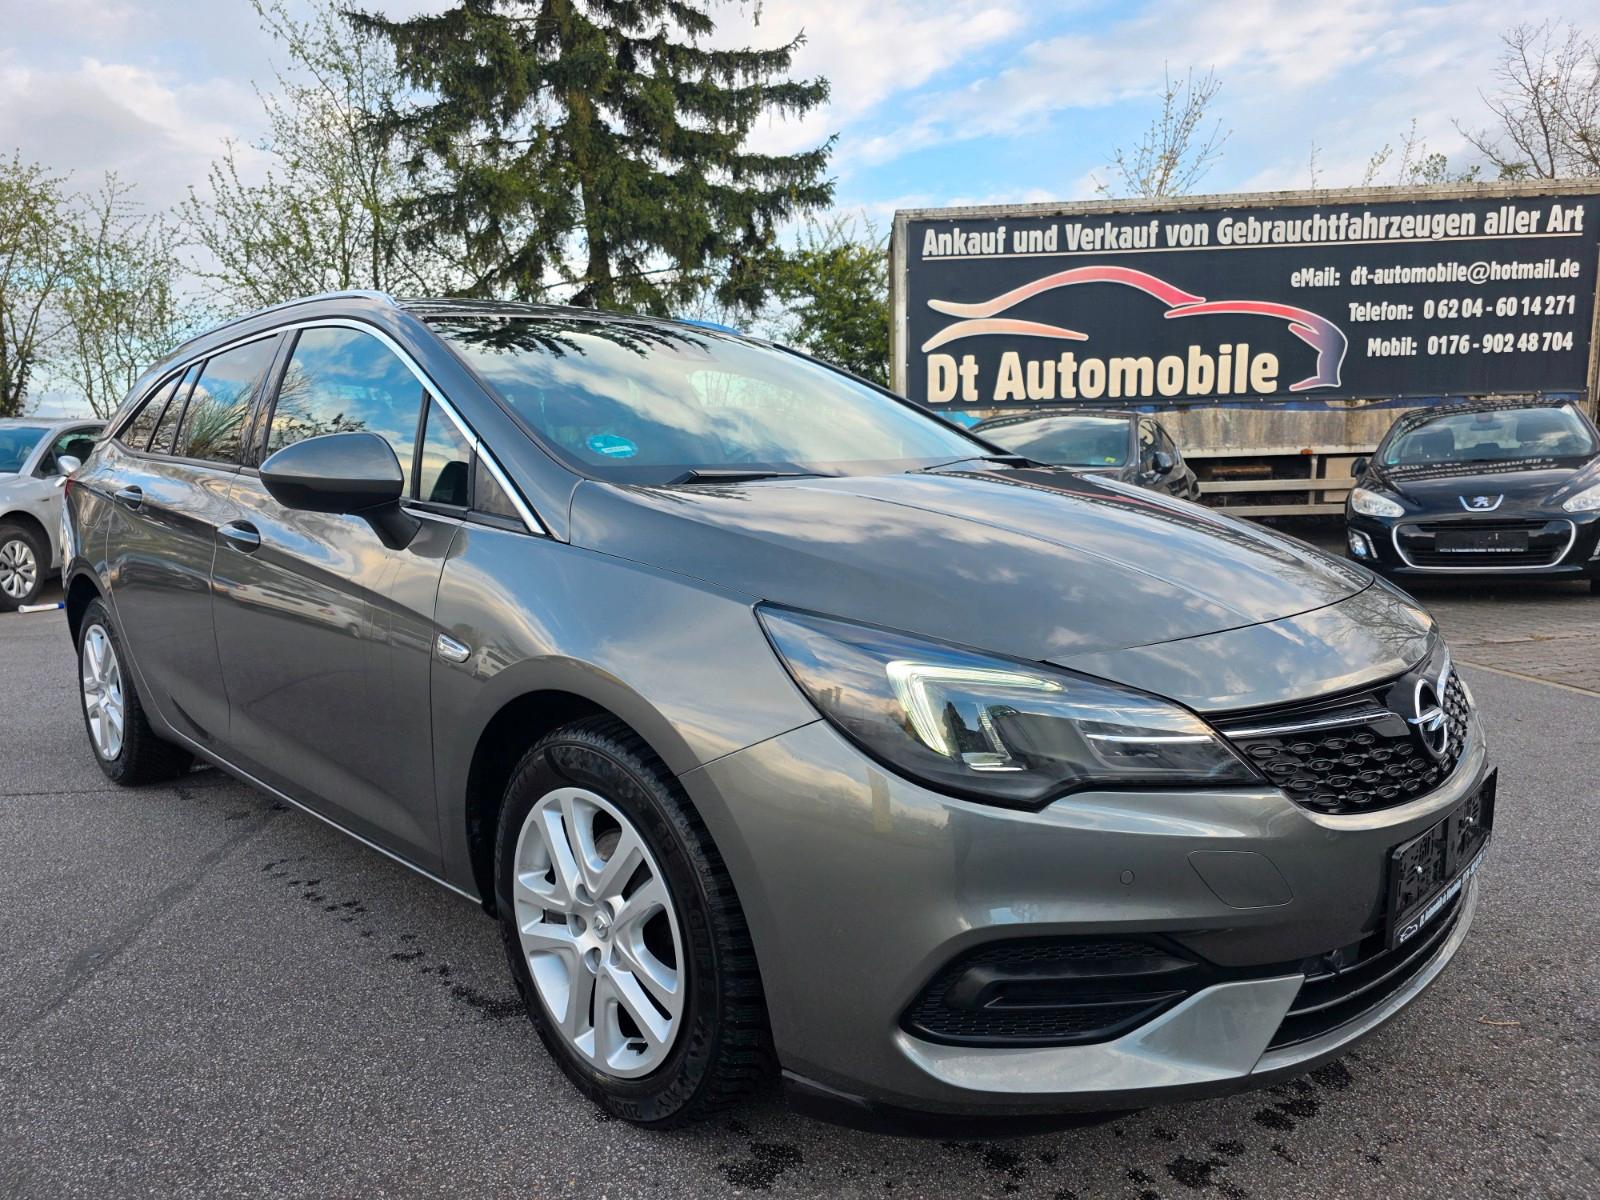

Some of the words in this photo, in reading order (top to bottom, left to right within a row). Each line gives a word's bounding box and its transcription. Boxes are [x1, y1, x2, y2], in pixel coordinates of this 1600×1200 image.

[922, 226, 1006, 256] Ankauf
[1013, 224, 1059, 254] und
[1065, 220, 1159, 250] Verkauf
[1165, 223, 1209, 246] von
[1217, 212, 1476, 240] Gebrauchtfahrzeugen
[1484, 206, 1541, 234] aller
[1545, 204, 1585, 233] Art
[1290, 266, 1341, 288] eMail:
[1350, 258, 1580, 285] dt-automobile@hotmail.de
[1348, 300, 1414, 322] Telefon:
[1366, 336, 1418, 358] Mobil:
[927, 353, 979, 402] Dt
[993, 343, 1279, 400] Automobile
